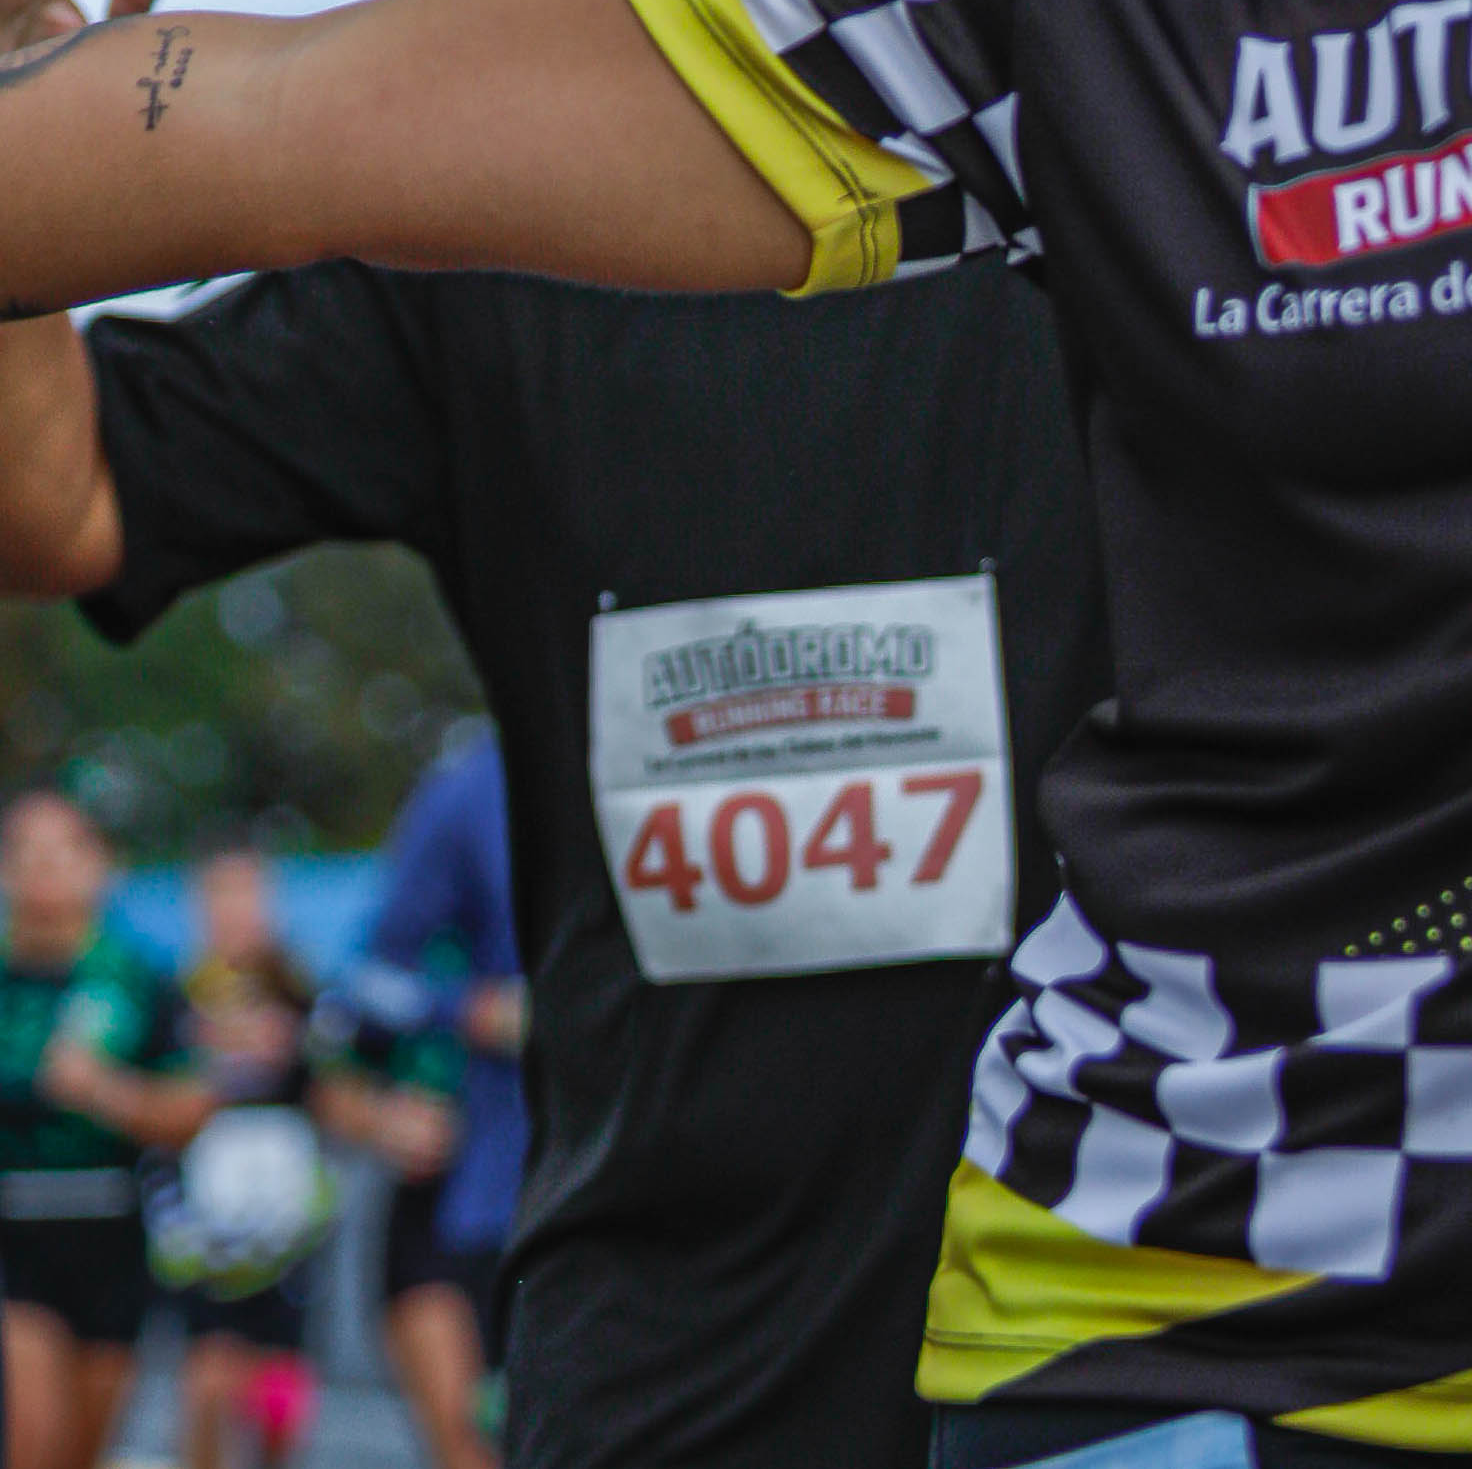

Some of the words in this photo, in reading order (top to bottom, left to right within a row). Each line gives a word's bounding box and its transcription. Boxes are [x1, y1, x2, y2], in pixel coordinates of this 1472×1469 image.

[1195, 286, 1249, 336] La
[1256, 281, 1418, 332] Carrera
[624, 770, 982, 912] 4047
